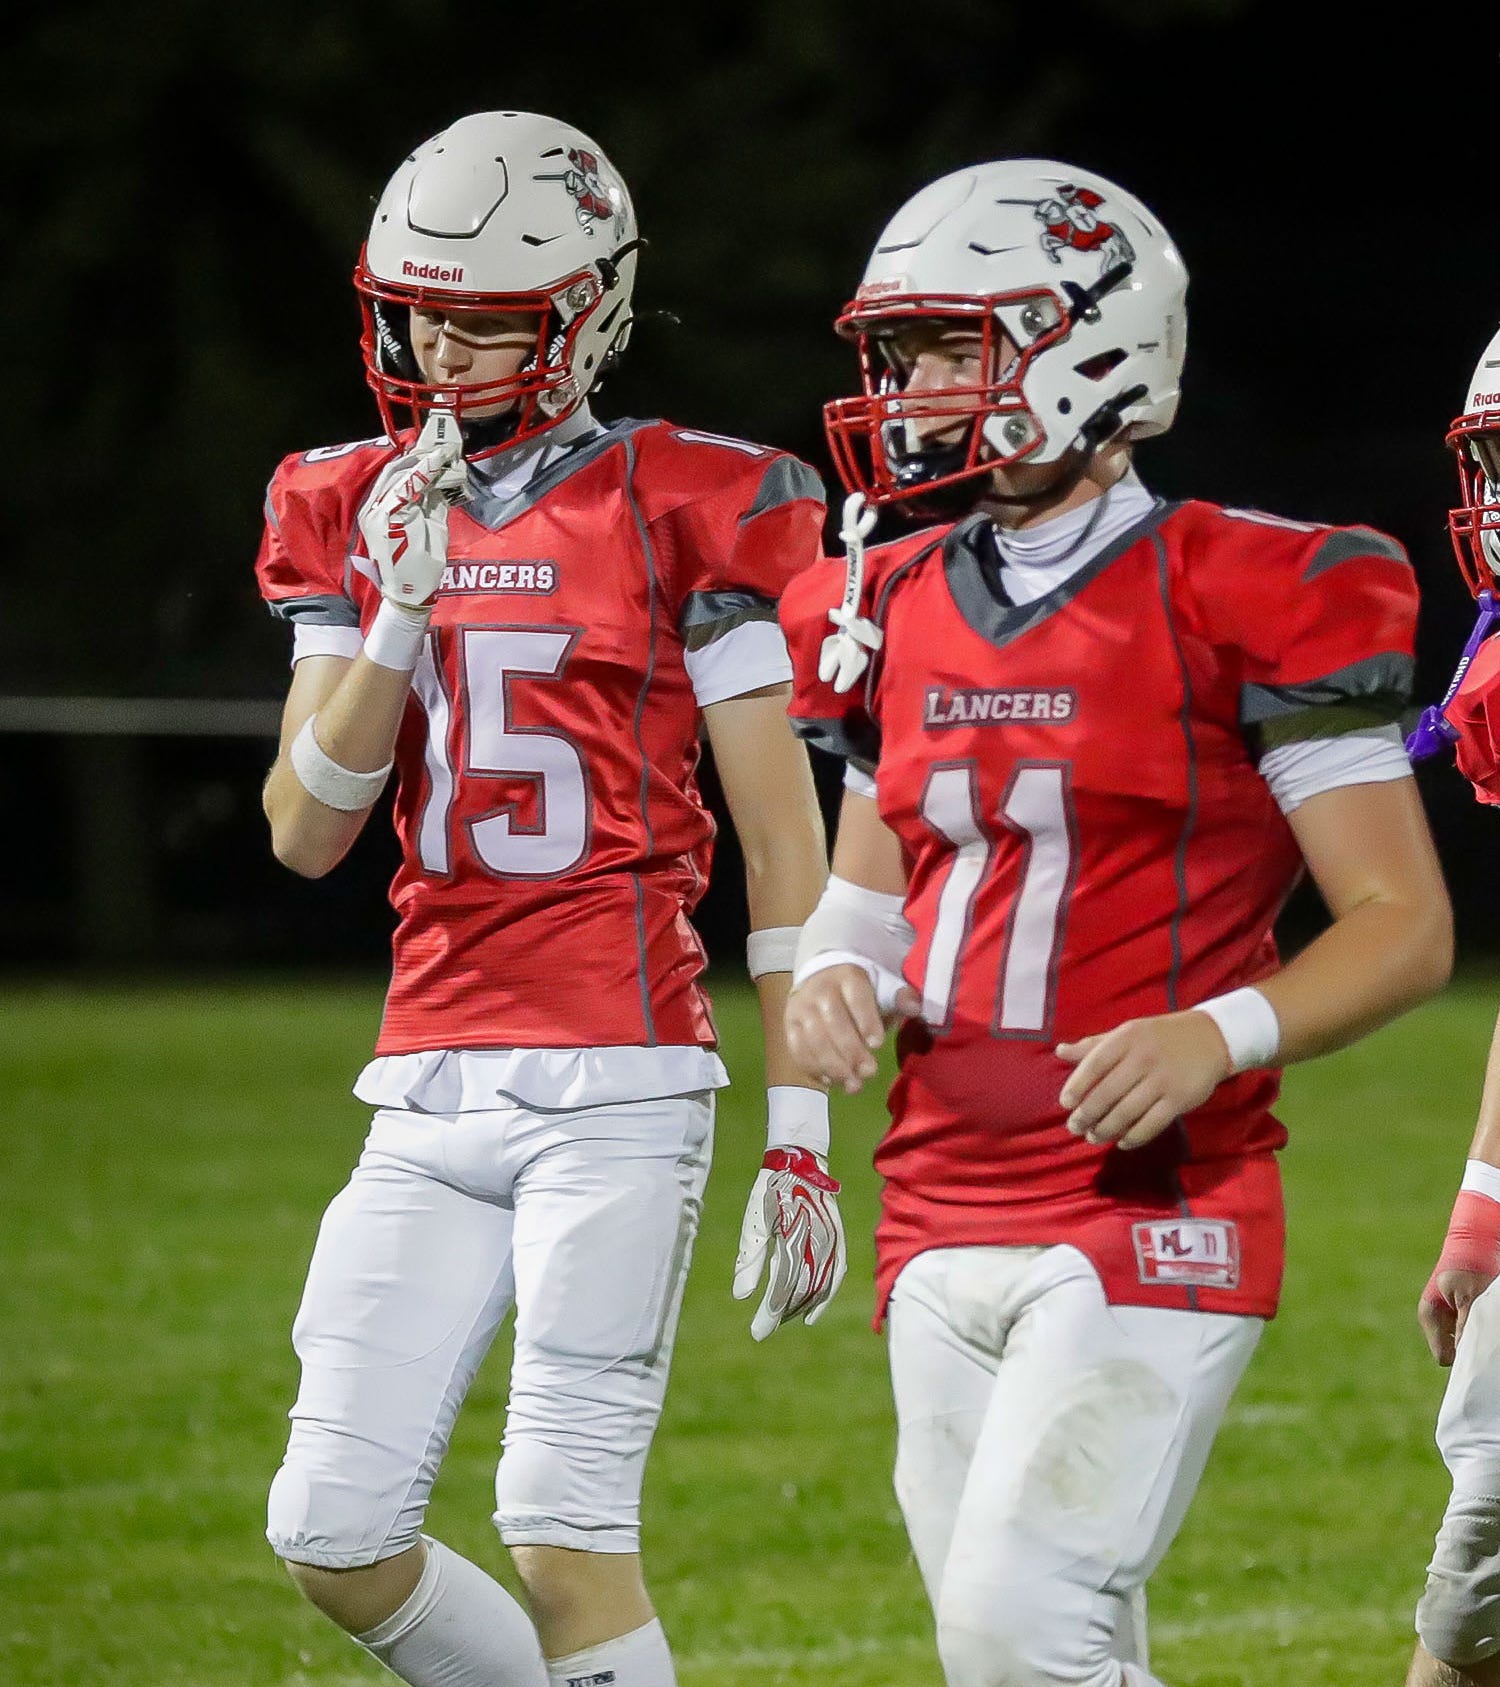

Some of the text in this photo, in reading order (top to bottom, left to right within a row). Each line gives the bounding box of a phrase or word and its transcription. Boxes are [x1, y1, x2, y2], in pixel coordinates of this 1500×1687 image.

[402, 260, 464, 283] Riddell
[437, 563, 556, 593] ANCERS
[923, 690, 1074, 725] LANCERS
[411, 626, 591, 880] 15
[921, 762, 1077, 1036] 11
